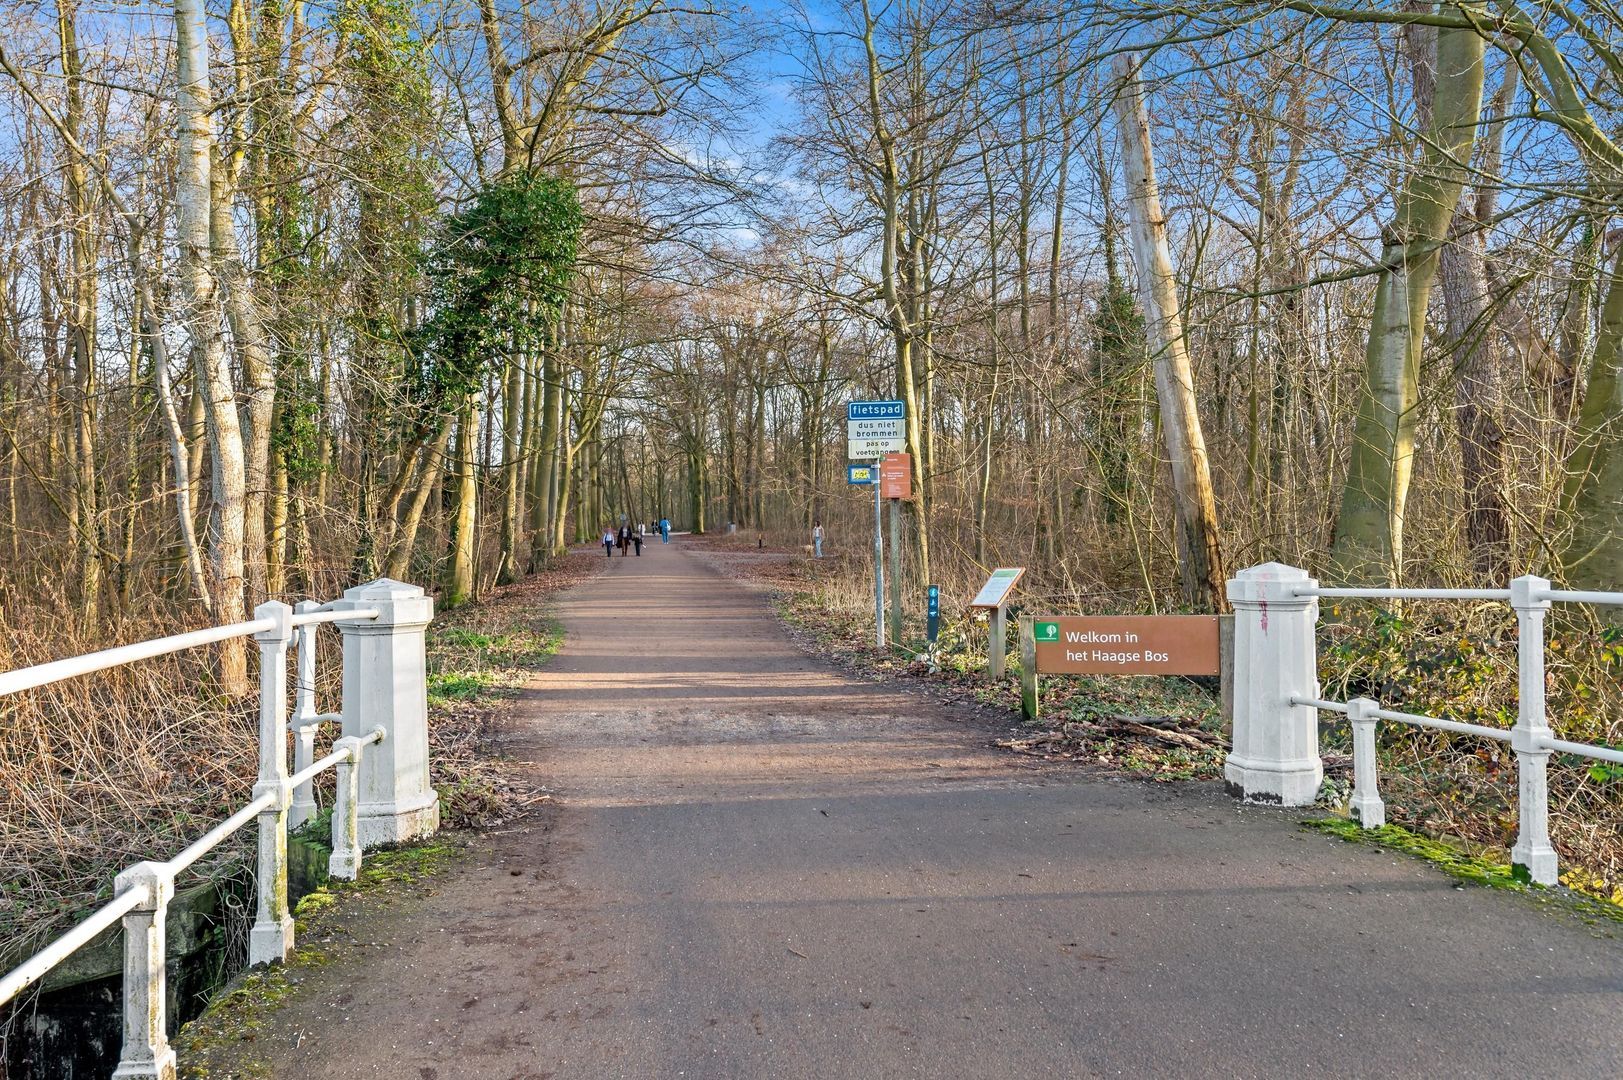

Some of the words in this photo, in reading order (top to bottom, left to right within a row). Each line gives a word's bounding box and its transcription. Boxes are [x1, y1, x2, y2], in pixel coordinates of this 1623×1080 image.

[852, 405, 901, 415] fietspad
[1065, 631, 1121, 643] Welkom
[1125, 631, 1138, 643] in
[1066, 649, 1088, 661] het
[1092, 650, 1140, 664] Haagse
[1144, 650, 1169, 662] Bos
